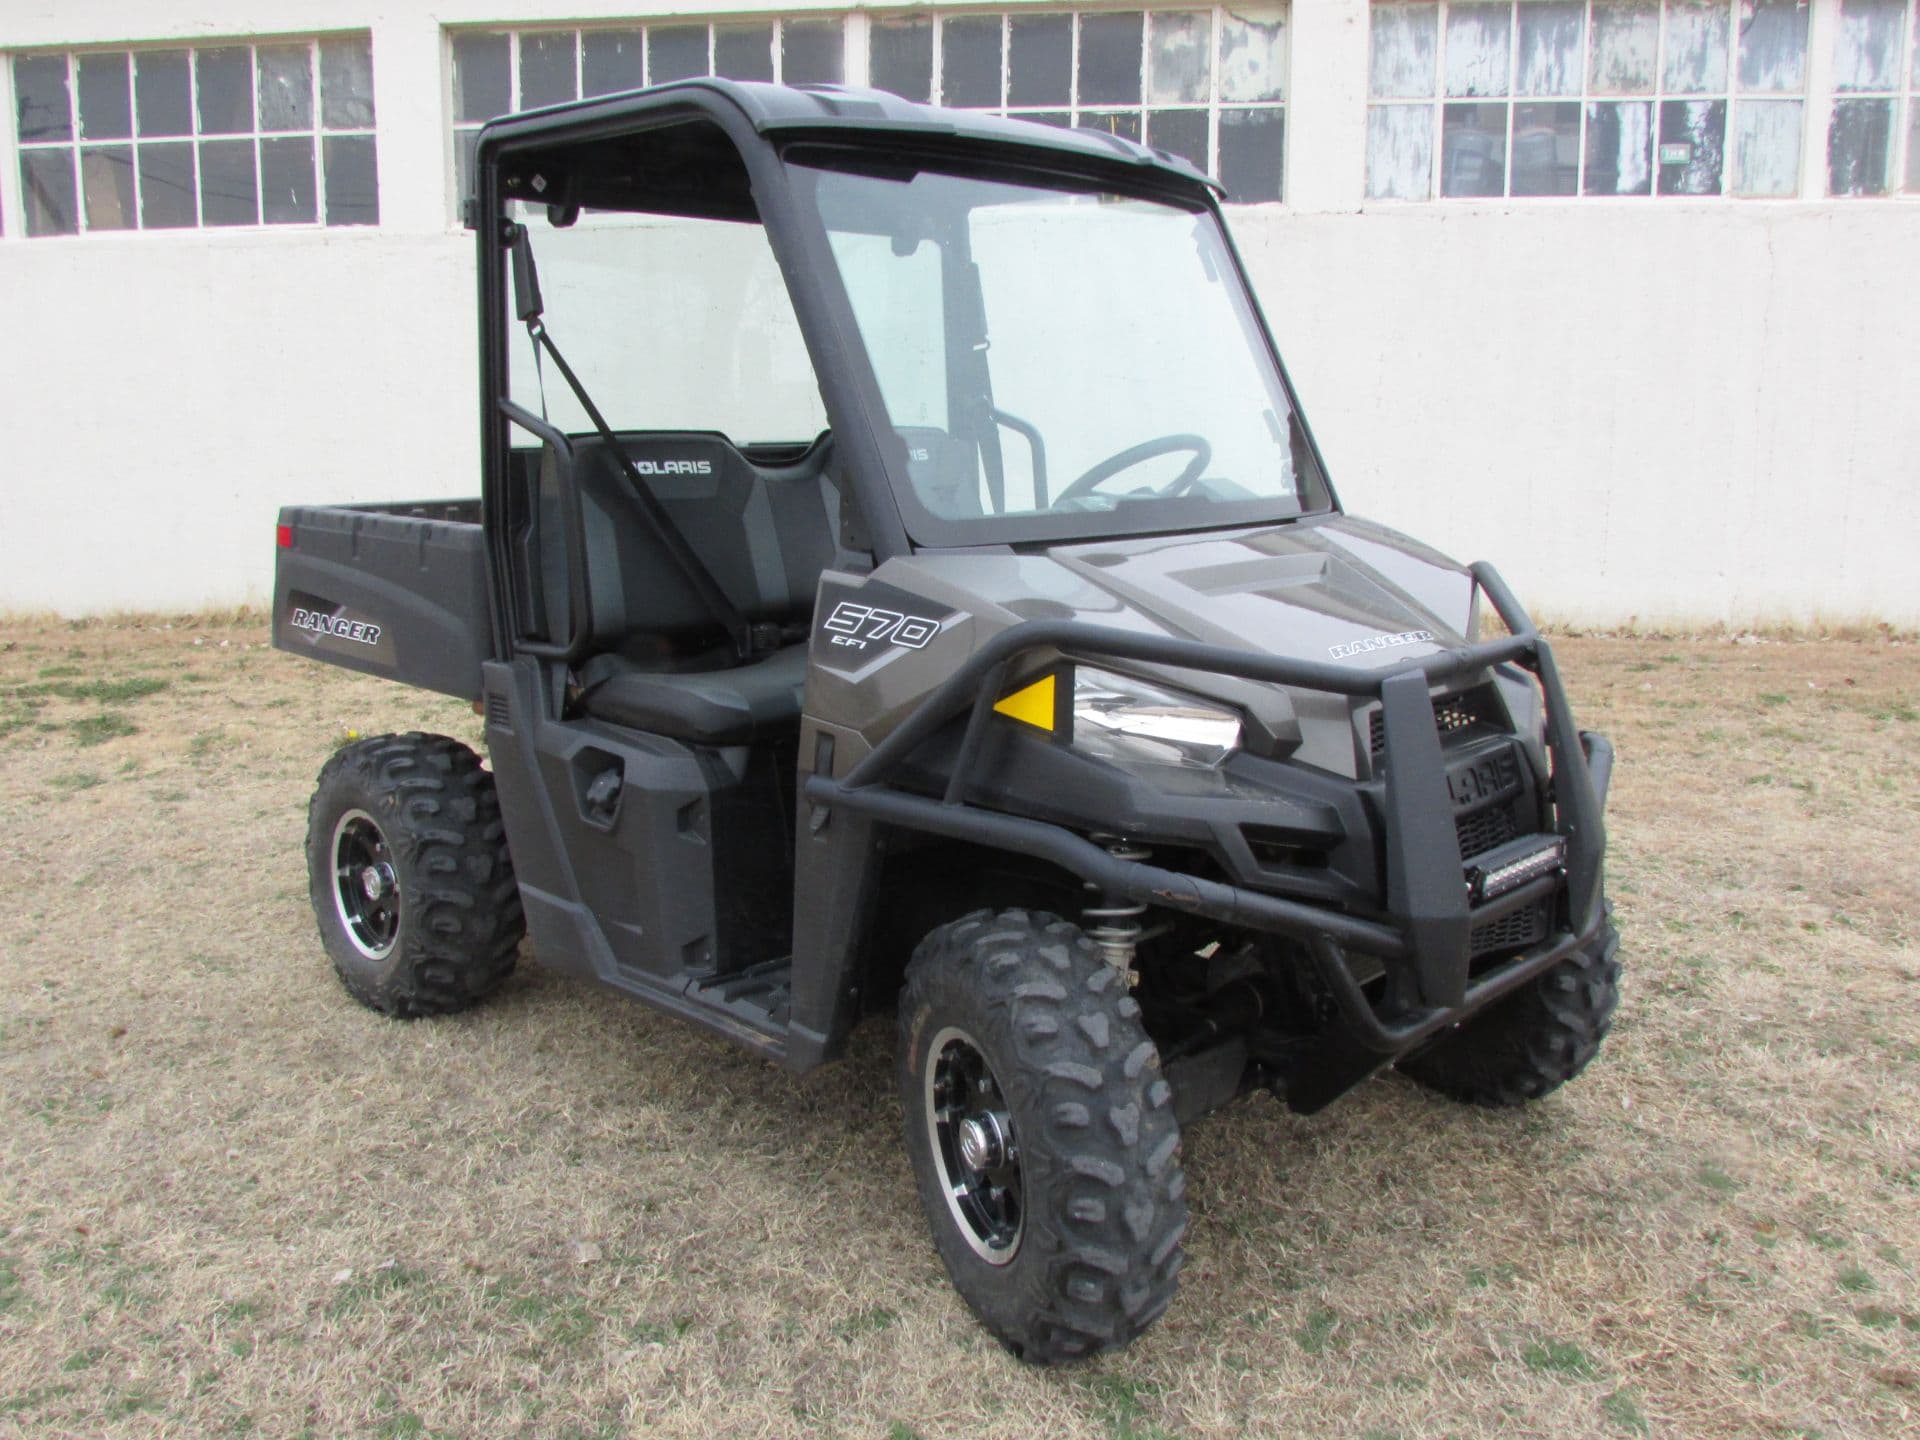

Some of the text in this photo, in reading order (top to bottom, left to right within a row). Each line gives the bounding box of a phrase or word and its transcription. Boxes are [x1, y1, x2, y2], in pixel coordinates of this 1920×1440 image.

[291, 608, 382, 645] RANGER
[824, 601, 941, 649] 570
[830, 634, 868, 650] EFI
[1328, 630, 1434, 660] RANGER
